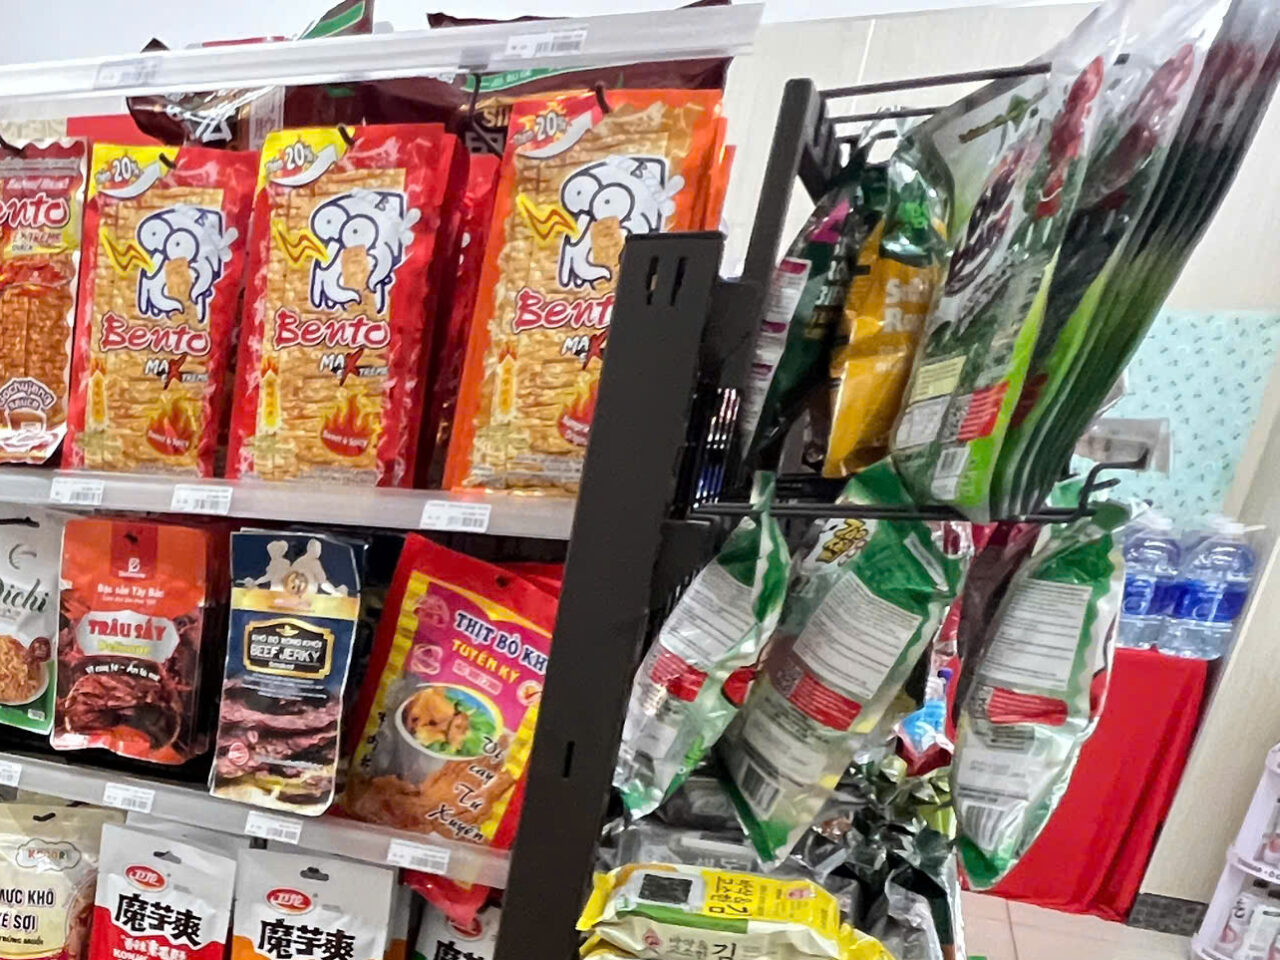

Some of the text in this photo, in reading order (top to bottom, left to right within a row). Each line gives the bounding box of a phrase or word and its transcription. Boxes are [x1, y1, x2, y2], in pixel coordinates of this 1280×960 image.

[513, 287, 616, 334] Bent
[100, 311, 211, 355] Bento
[274, 308, 391, 350] Bento
[250, 644, 321, 663] BEEF JERKY
[521, 648, 549, 676] KH
[468, 764, 496, 788] cay
[27, 888, 55, 906] KHÔ
[114, 893, 203, 948] 魔芋爽
